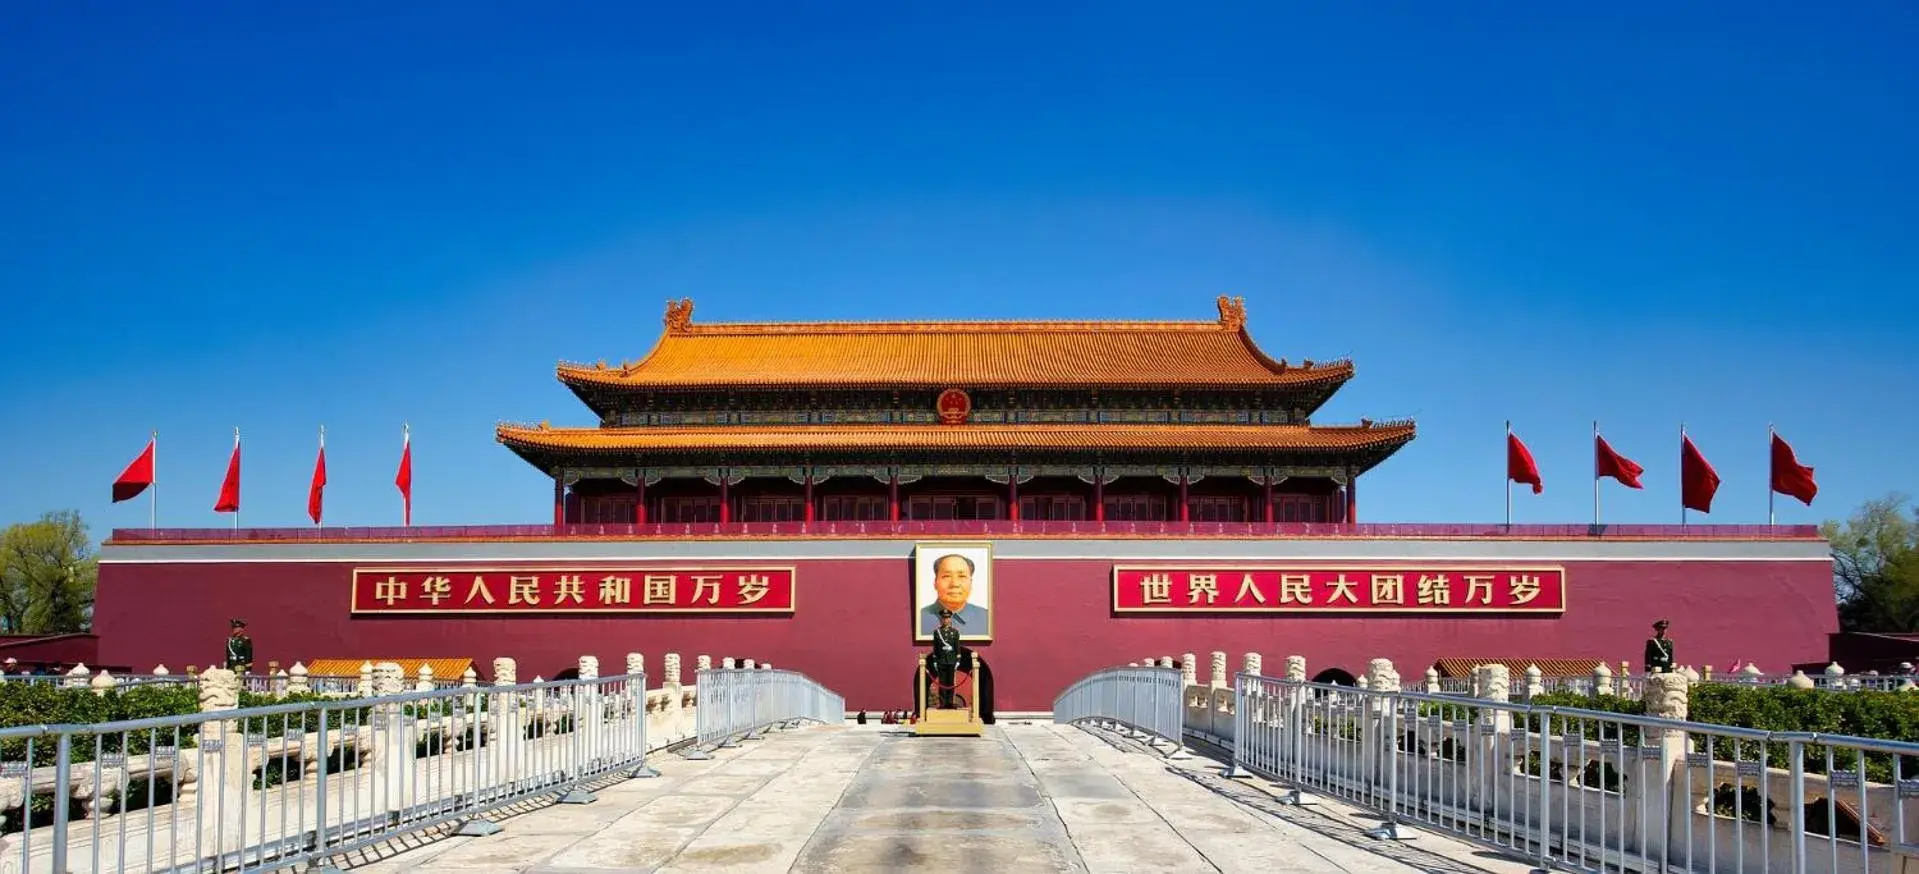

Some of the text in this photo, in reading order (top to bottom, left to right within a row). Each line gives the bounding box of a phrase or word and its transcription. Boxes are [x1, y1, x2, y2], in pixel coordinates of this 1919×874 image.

[375, 574, 770, 605] 中华人民共和国万岁
[1140, 573, 1541, 605] 世界人民大团结万岁
